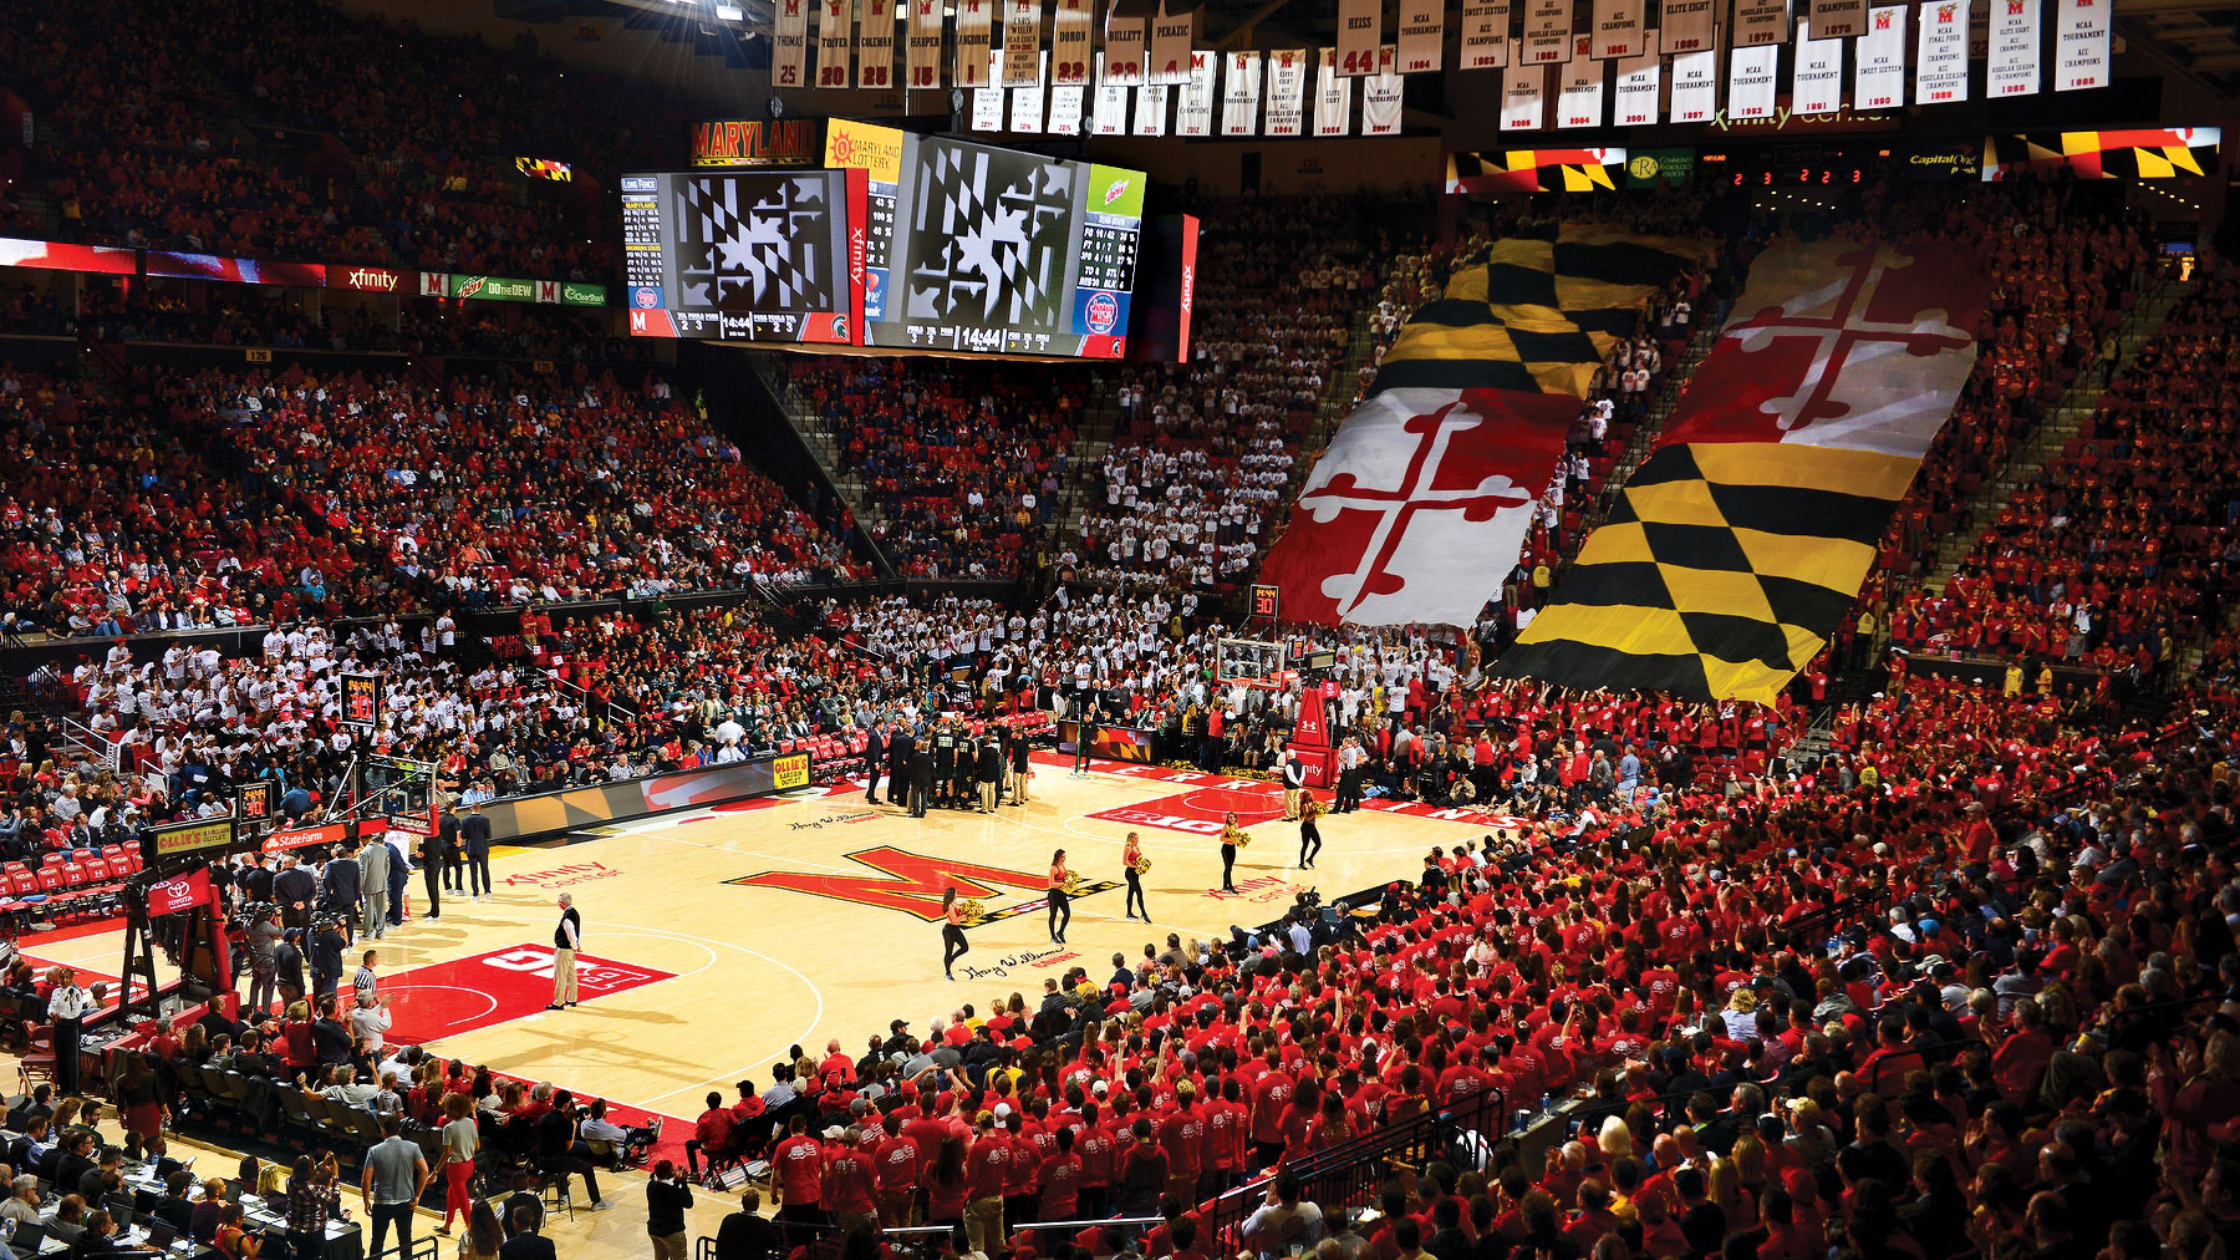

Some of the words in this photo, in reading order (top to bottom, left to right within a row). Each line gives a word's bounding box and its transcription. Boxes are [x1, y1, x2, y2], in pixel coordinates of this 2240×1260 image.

[1464, 7, 1483, 17] SWEET
[1484, 5, 1509, 16] SIXTEEN
[1666, 4, 1688, 15] ELITE
[1688, 1, 1710, 13] EIGHT
[1817, 1, 1860, 13] CHAMPIONS
[1413, 14, 1430, 23] NCAA
[1612, 11, 1625, 20] ACC
[1347, 16, 1372, 30] HEISS
[1479, 24, 1492, 33] ACC
[1601, 20, 1636, 30] CHAMPIONS
[2075, 21, 2092, 29] NCAA
[1060, 31, 1086, 42] DORON
[1109, 30, 1142, 42] BULLETT
[1401, 24, 1442, 37] TOURNAMENT
[2063, 30, 2105, 41] TOURNAMENT
[777, 35, 803, 47] THOMAS
[861, 36, 892, 48] COLEMAN
[910, 36, 939, 47] HARPER
[1466, 35, 1503, 46] CHAMPIONS
[2077, 48, 2089, 56] ACC
[1343, 50, 1373, 73] 44
[1809, 61, 1826, 69] NCAA
[2064, 58, 2101, 68] CHAMPIONS
[781, 65, 796, 84] 25
[820, 66, 845, 86] 20
[863, 66, 888, 86] 25
[913, 66, 933, 86] 15
[966, 64, 974, 84] 1
[1058, 61, 1085, 83] 22
[1630, 74, 1646, 82] NCAA
[1797, 71, 1838, 81] TOURNAMENT
[1675, 80, 1714, 90] TOURNAMENT
[1733, 76, 1773, 85] TOURNAMENT
[1619, 84, 1656, 93] TOURNAMENT
[691, 119, 816, 158] MARYLAND
[854, 139, 900, 158] MARYLAND
[853, 153, 890, 170] LOTTERY
[1734, 173, 1743, 186] 2
[1763, 172, 1772, 185] 3
[1800, 168, 1809, 182] 2
[1821, 170, 1831, 184] 2
[1852, 169, 1861, 183] 3
[850, 226, 866, 285] xfinity
[349, 268, 398, 292] xfinity
[427, 273, 442, 293] M
[541, 281, 555, 301] M
[1181, 264, 1193, 313] xfinity
[632, 311, 647, 331] M
[681, 321, 689, 331] 2
[695, 321, 703, 331] 3
[723, 316, 750, 329] 14:44
[773, 322, 780, 333] 2
[786, 323, 794, 333] 3
[962, 327, 1000, 348] 14:44
[251, 350, 266, 361] 126
[1256, 588, 1276, 598] 14:44
[1256, 598, 1273, 613] 30
[350, 693, 372, 719] 30
[494, 861, 606, 886] xfinity
[167, 895, 194, 905] TOYOTA
[1000, 946, 1065, 967] Williams
